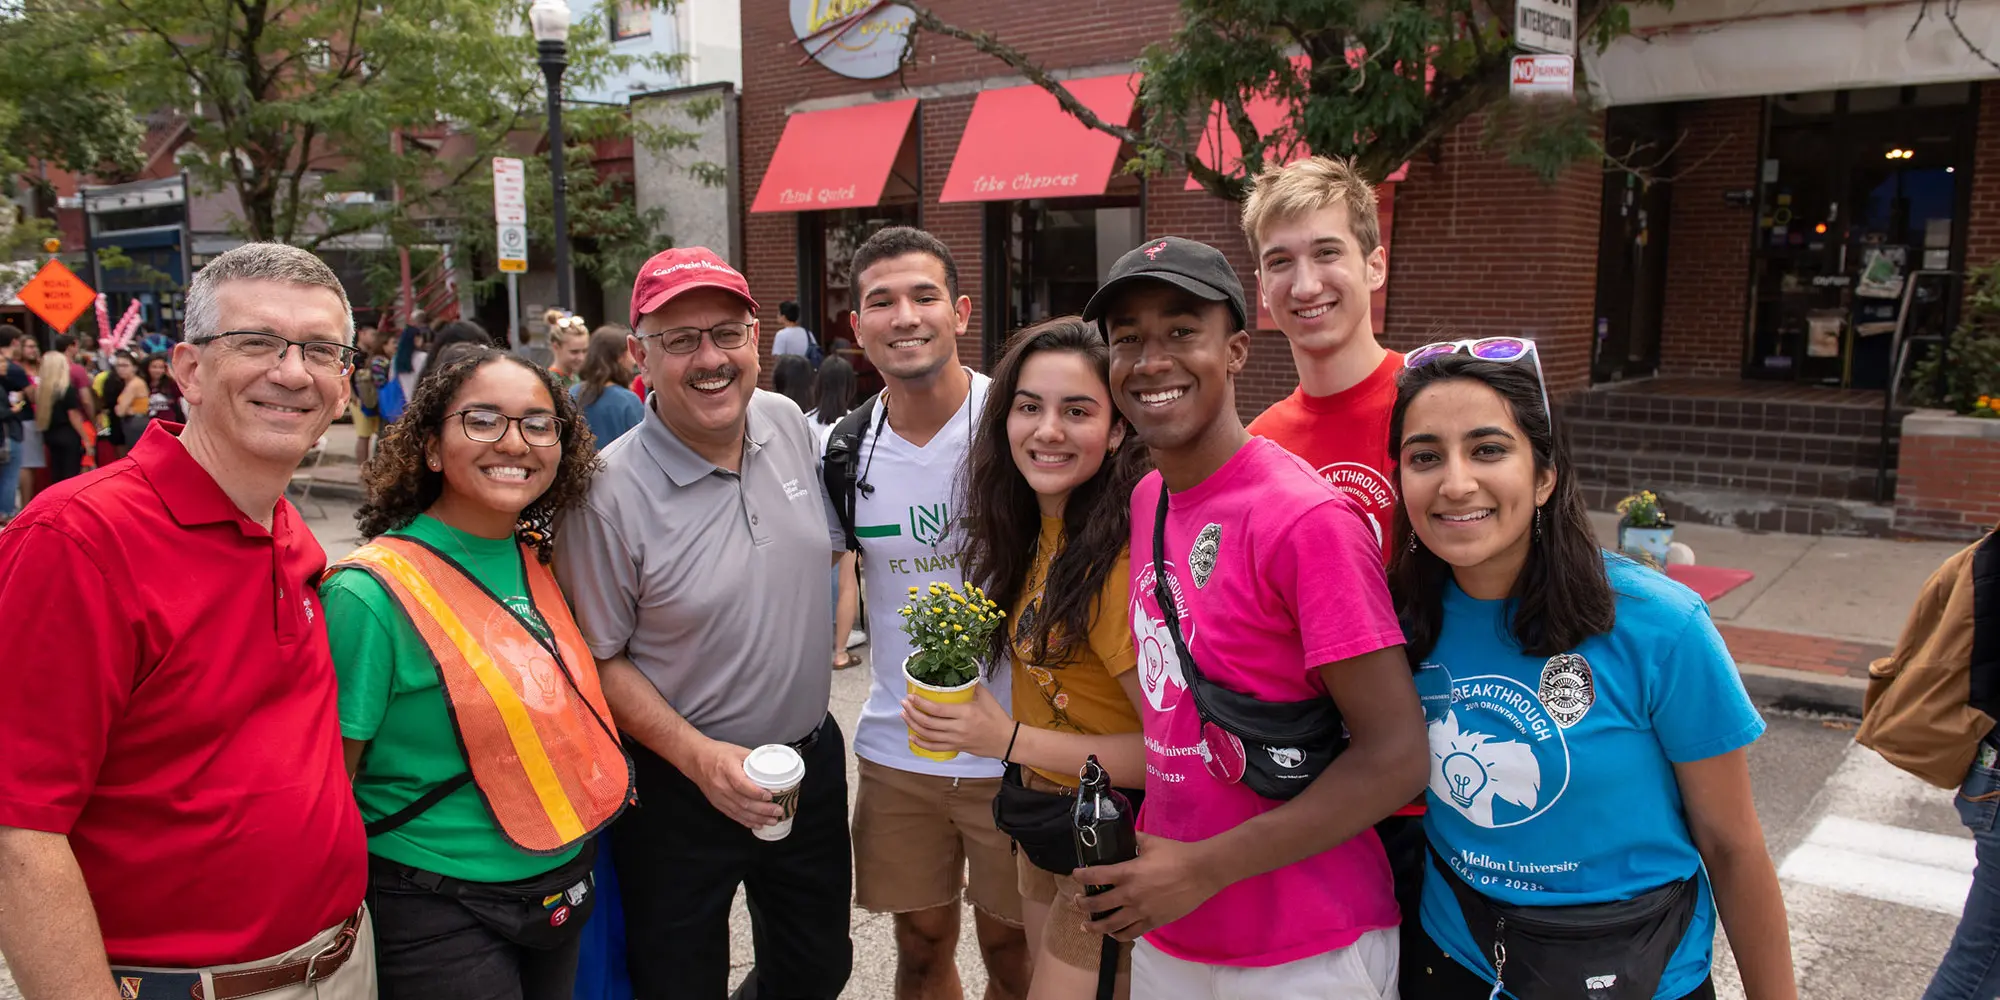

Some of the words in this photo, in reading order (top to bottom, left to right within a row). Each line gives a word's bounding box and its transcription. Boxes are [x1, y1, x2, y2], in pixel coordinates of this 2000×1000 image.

[1521, 6, 1571, 40] INTERSECTION
[1514, 60, 1533, 80] NO
[1534, 64, 1570, 77] PARKING
[973, 176, 1006, 192] Take
[1012, 172, 1079, 190] Chances
[780, 187, 813, 204] Think
[818, 184, 855, 203] Quick
[652, 261, 701, 276] Carnegie
[1325, 470, 1391, 509] AKTHROUGH
[889, 559, 911, 574] FC
[1140, 570, 1189, 620] BREAHROUGH
[1451, 683, 1552, 742] BREAKTHROUGH
[1480, 701, 1528, 735] ORIENTATION
[1461, 849, 1507, 871] Mellon
[1508, 851, 1580, 874] University
[1481, 875, 1499, 885] OF
[1504, 878, 1544, 892] 2023+
